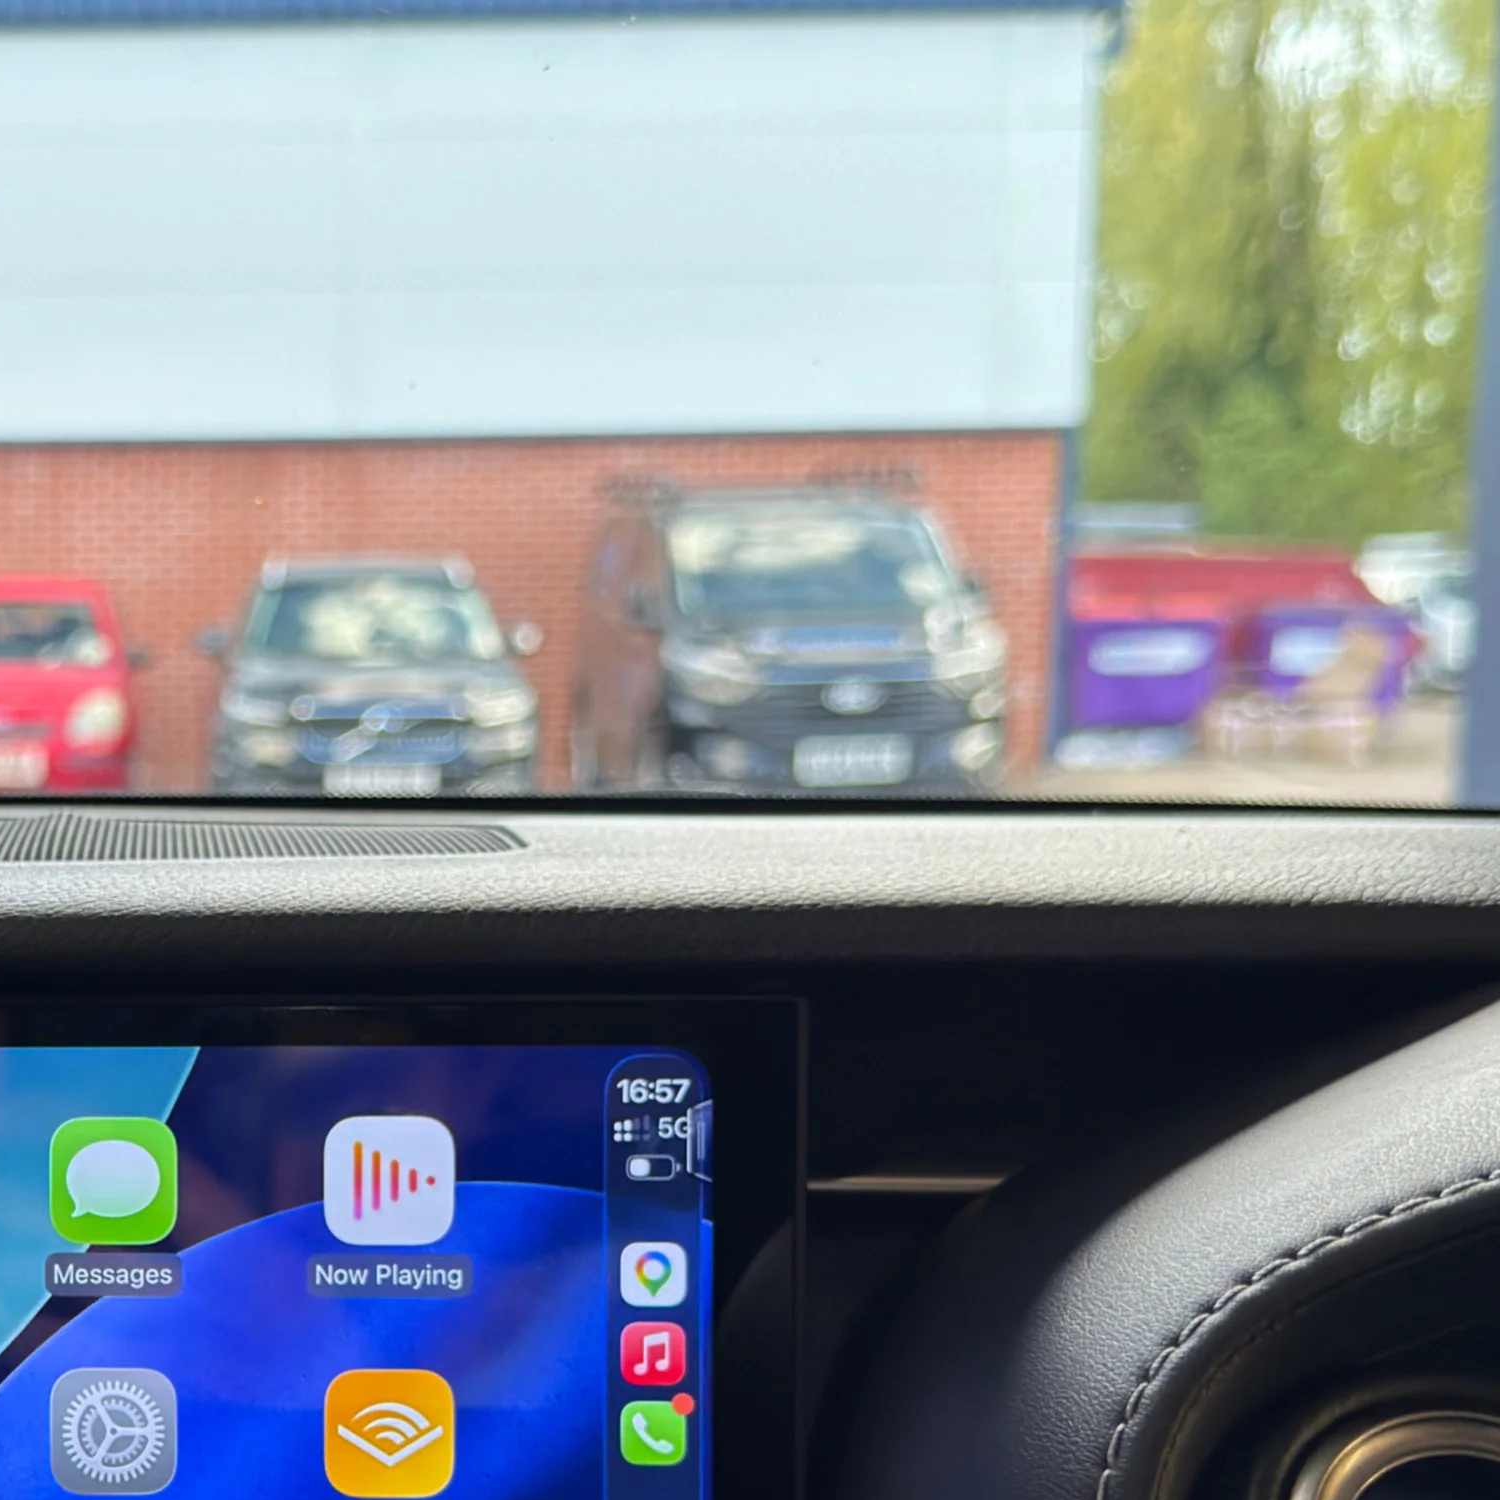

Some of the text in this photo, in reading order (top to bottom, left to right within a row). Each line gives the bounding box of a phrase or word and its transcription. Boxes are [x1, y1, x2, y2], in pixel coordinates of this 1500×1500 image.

[616, 1078, 691, 1104] 16:57
[658, 1117, 690, 1139] 5G
[52, 1263, 173, 1288] Messages
[314, 1264, 463, 1290] Now Playing
